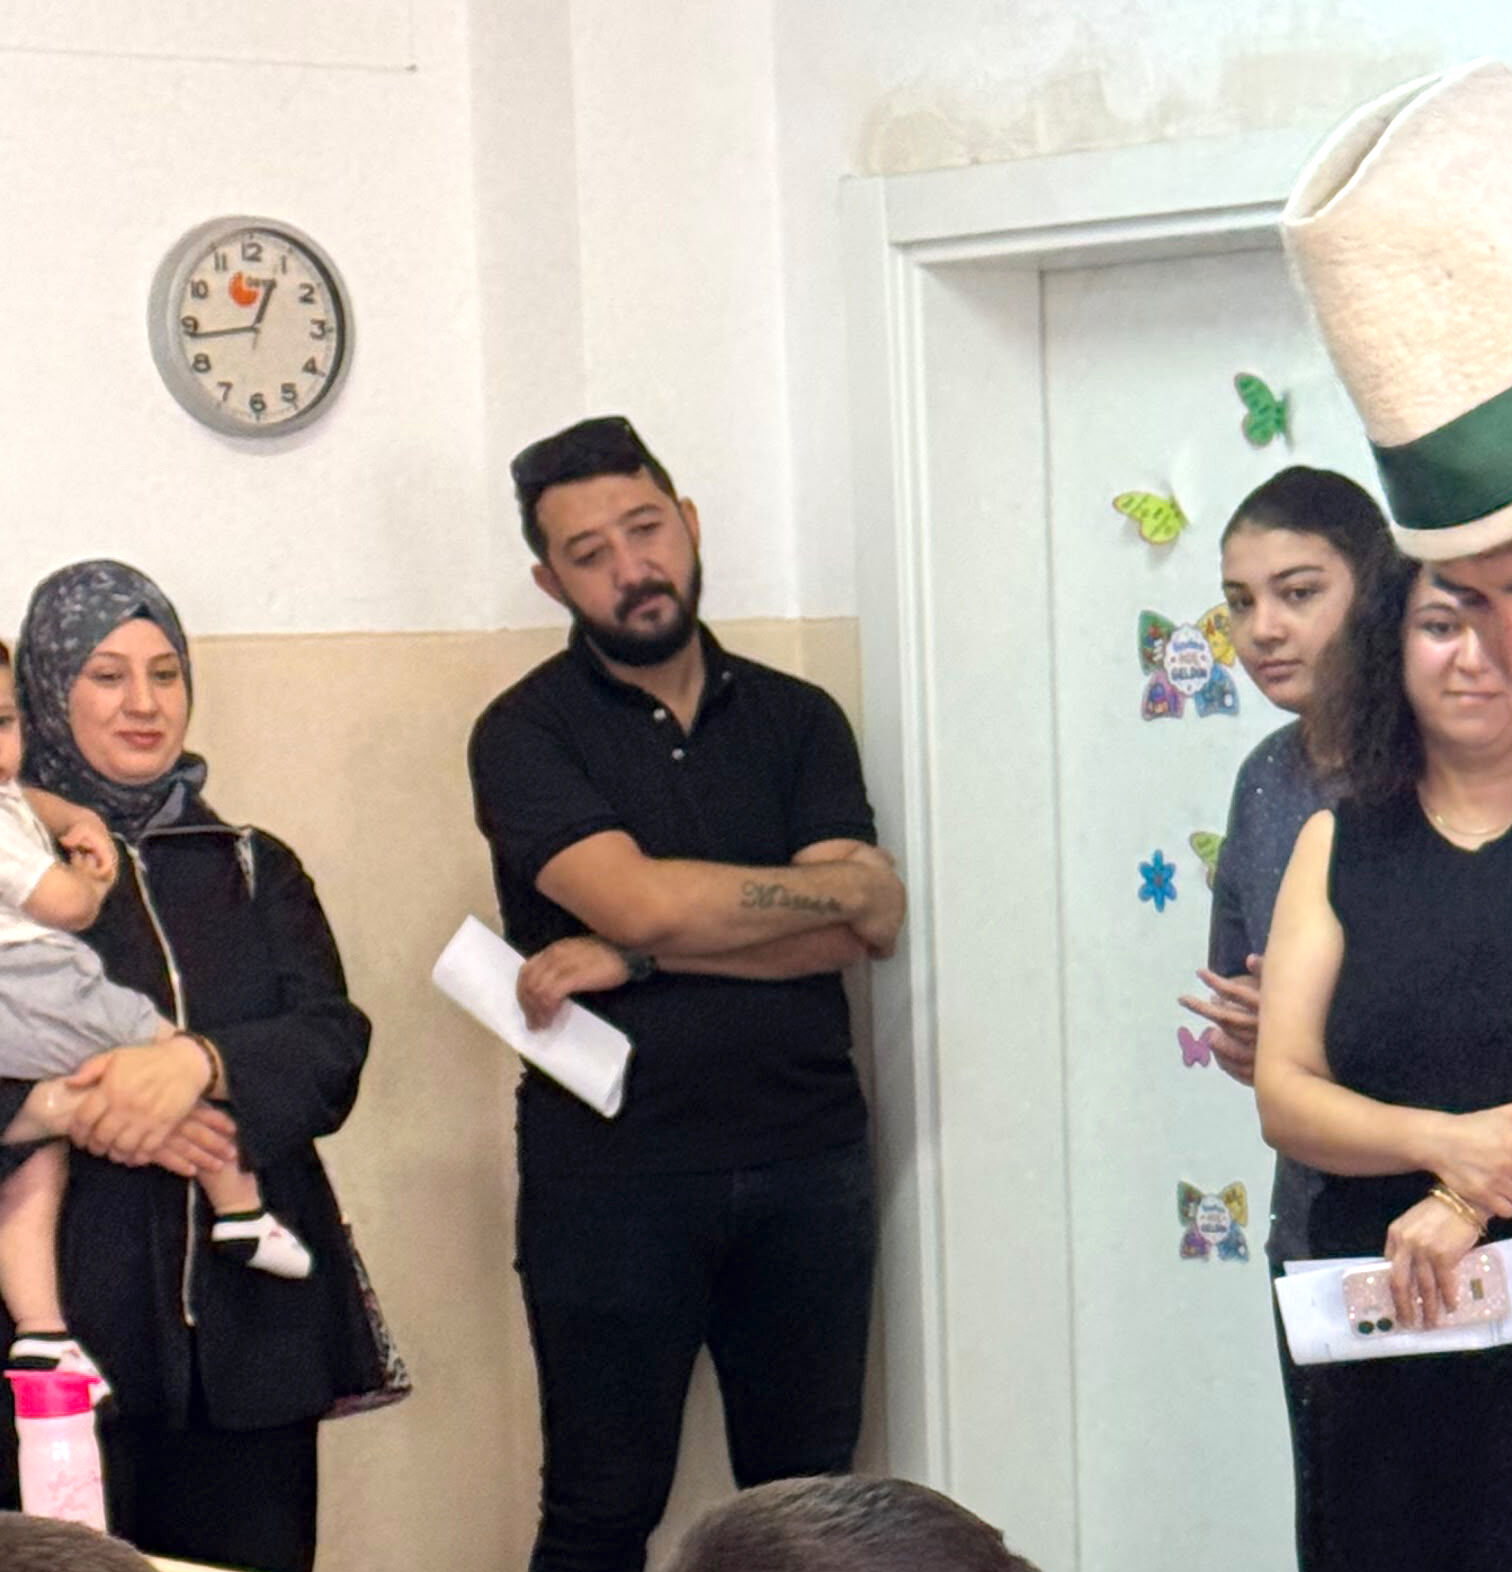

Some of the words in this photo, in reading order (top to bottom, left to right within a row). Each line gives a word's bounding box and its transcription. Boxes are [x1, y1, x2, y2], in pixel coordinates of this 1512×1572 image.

[214, 252, 228, 271] 11
[241, 243, 263, 262] 12
[280, 255, 287, 274] 1
[191, 279, 208, 299] 10
[299, 283, 315, 304] 2
[181, 315, 199, 337] 9
[309, 319, 326, 340] 3
[192, 353, 212, 373] 8
[302, 357, 318, 374] 4
[217, 382, 233, 402] 7
[281, 382, 298, 403] 5
[249, 393, 267, 412] 6
